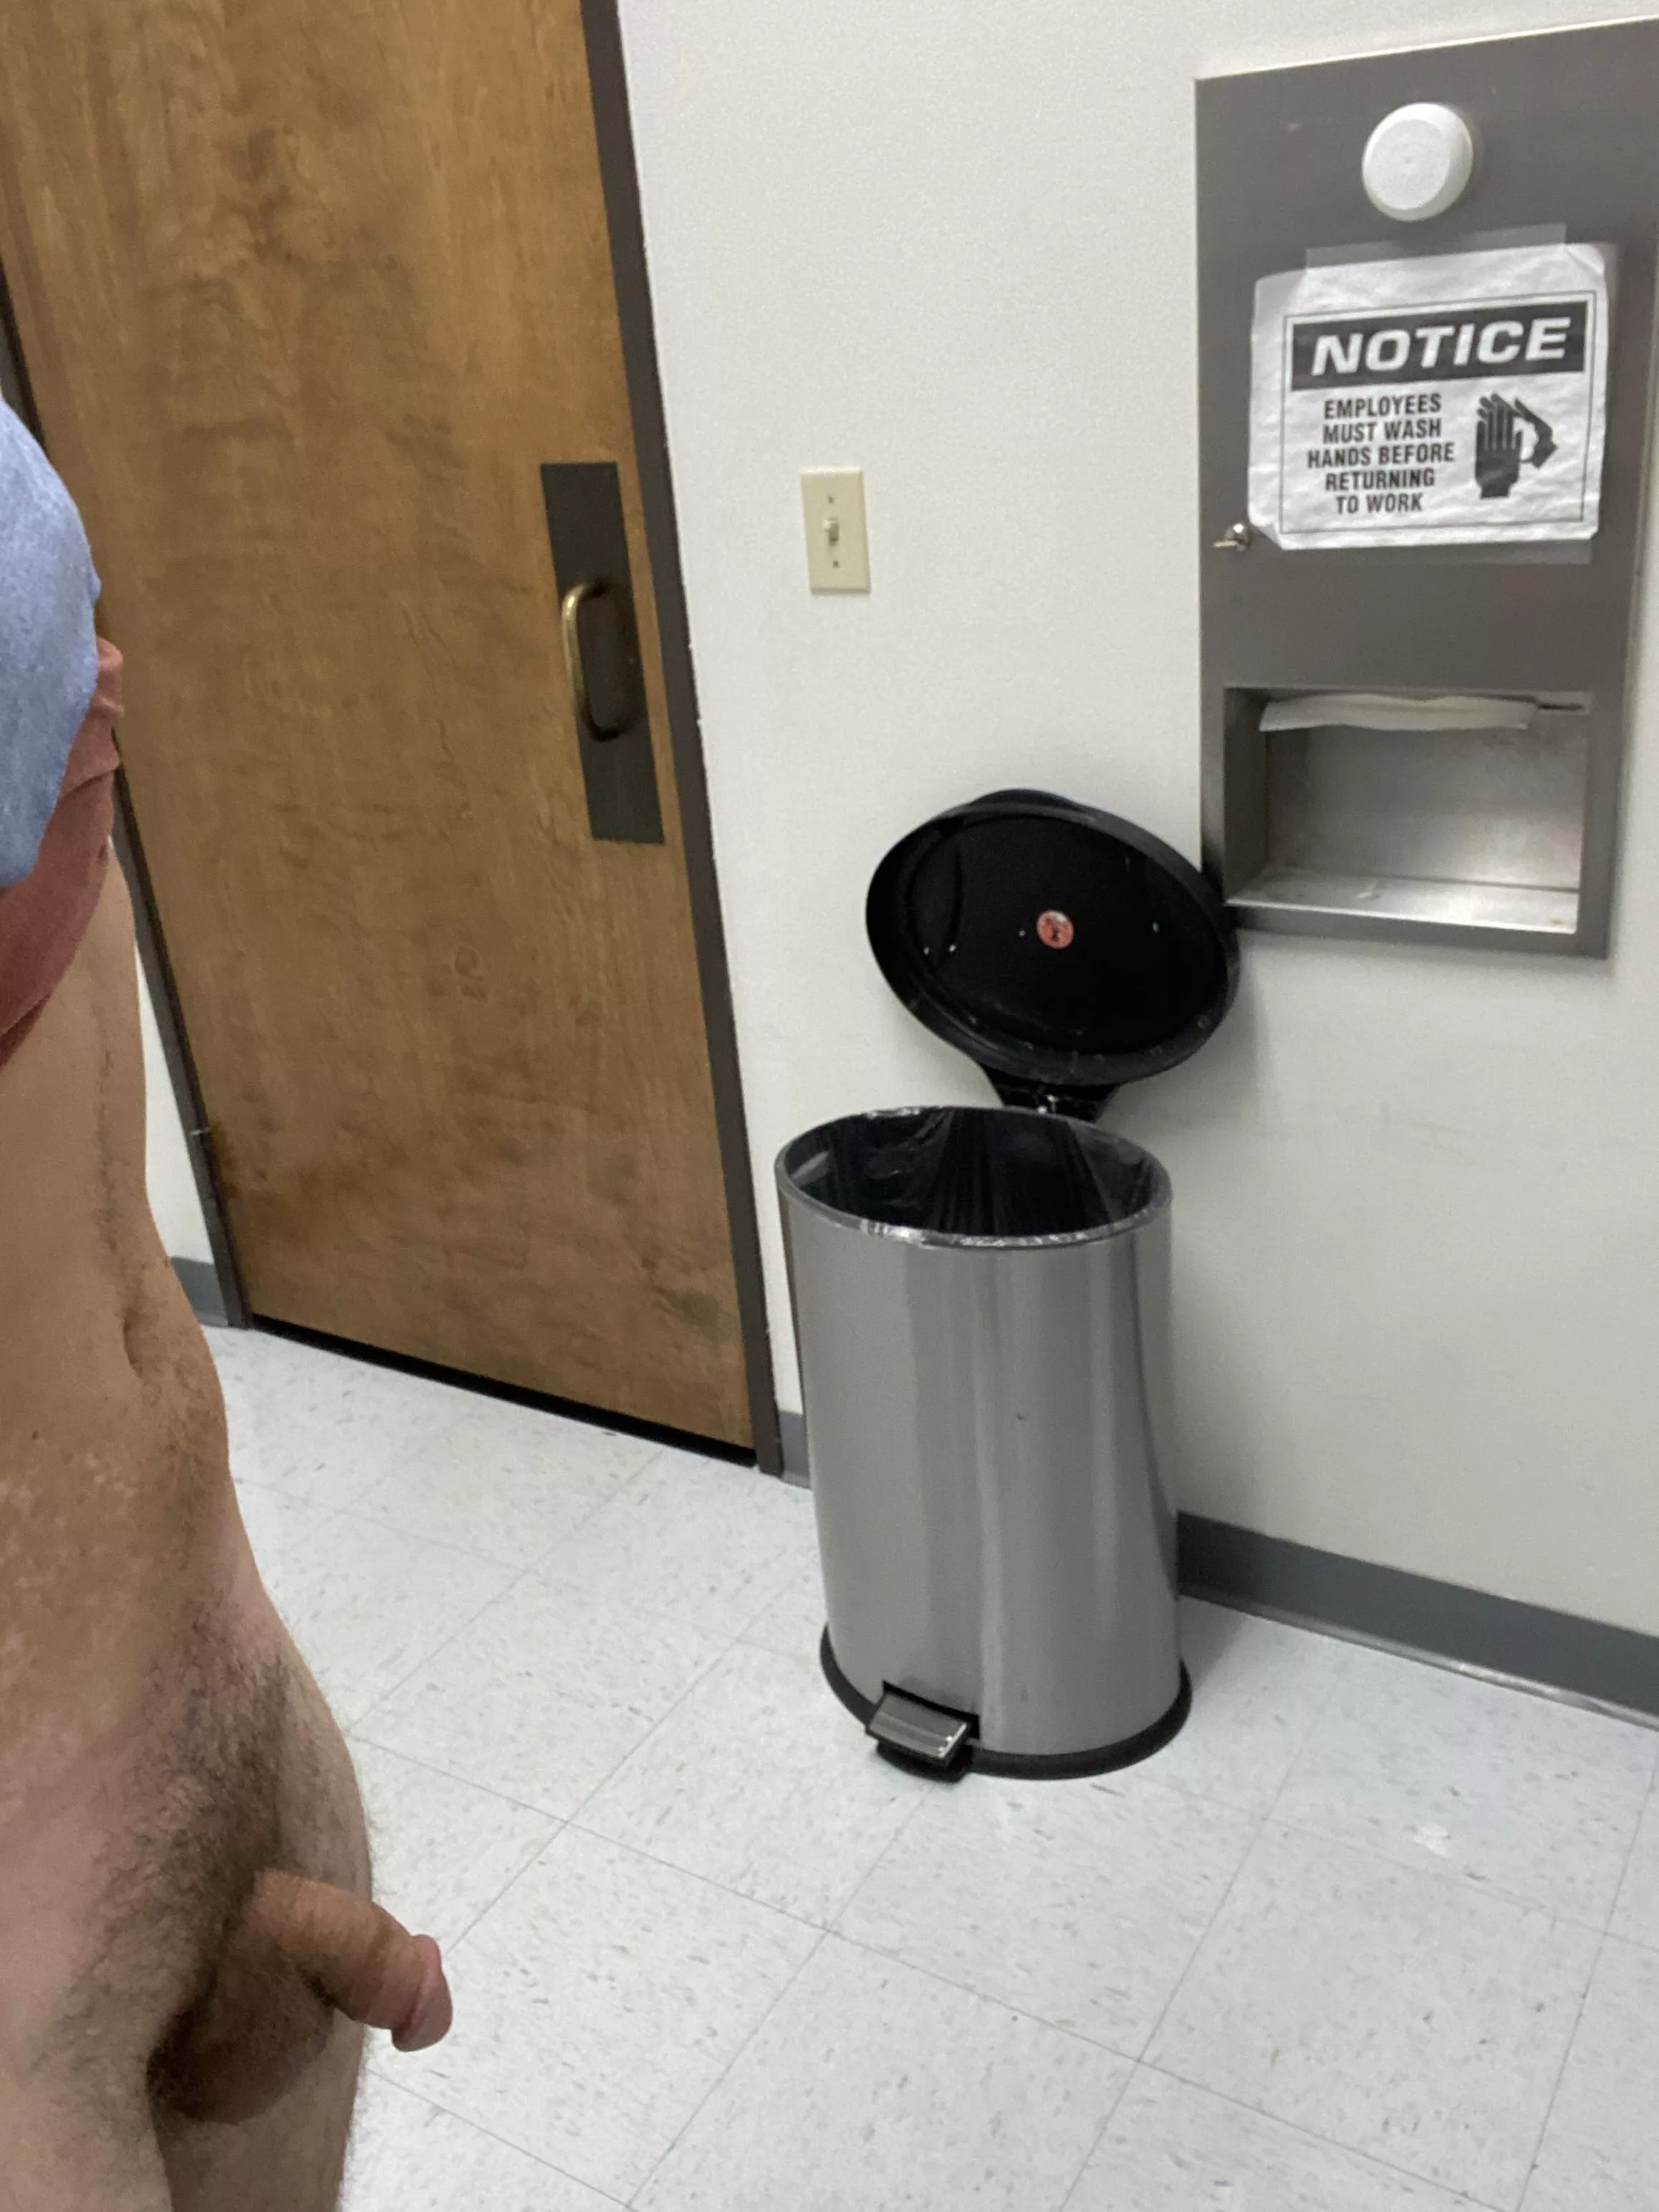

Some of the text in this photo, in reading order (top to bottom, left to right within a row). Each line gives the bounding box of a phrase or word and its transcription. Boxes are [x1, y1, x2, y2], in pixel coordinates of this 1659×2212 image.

[1312, 317, 1572, 376] NOTICE
[1324, 393, 1442, 419] EMPLOYEES
[1322, 418, 1442, 444] MUST WASH
[1307, 442, 1456, 468] HANDS BEFORE
[1325, 469, 1435, 492] RETURNING
[1336, 493, 1423, 514] TO WORK
